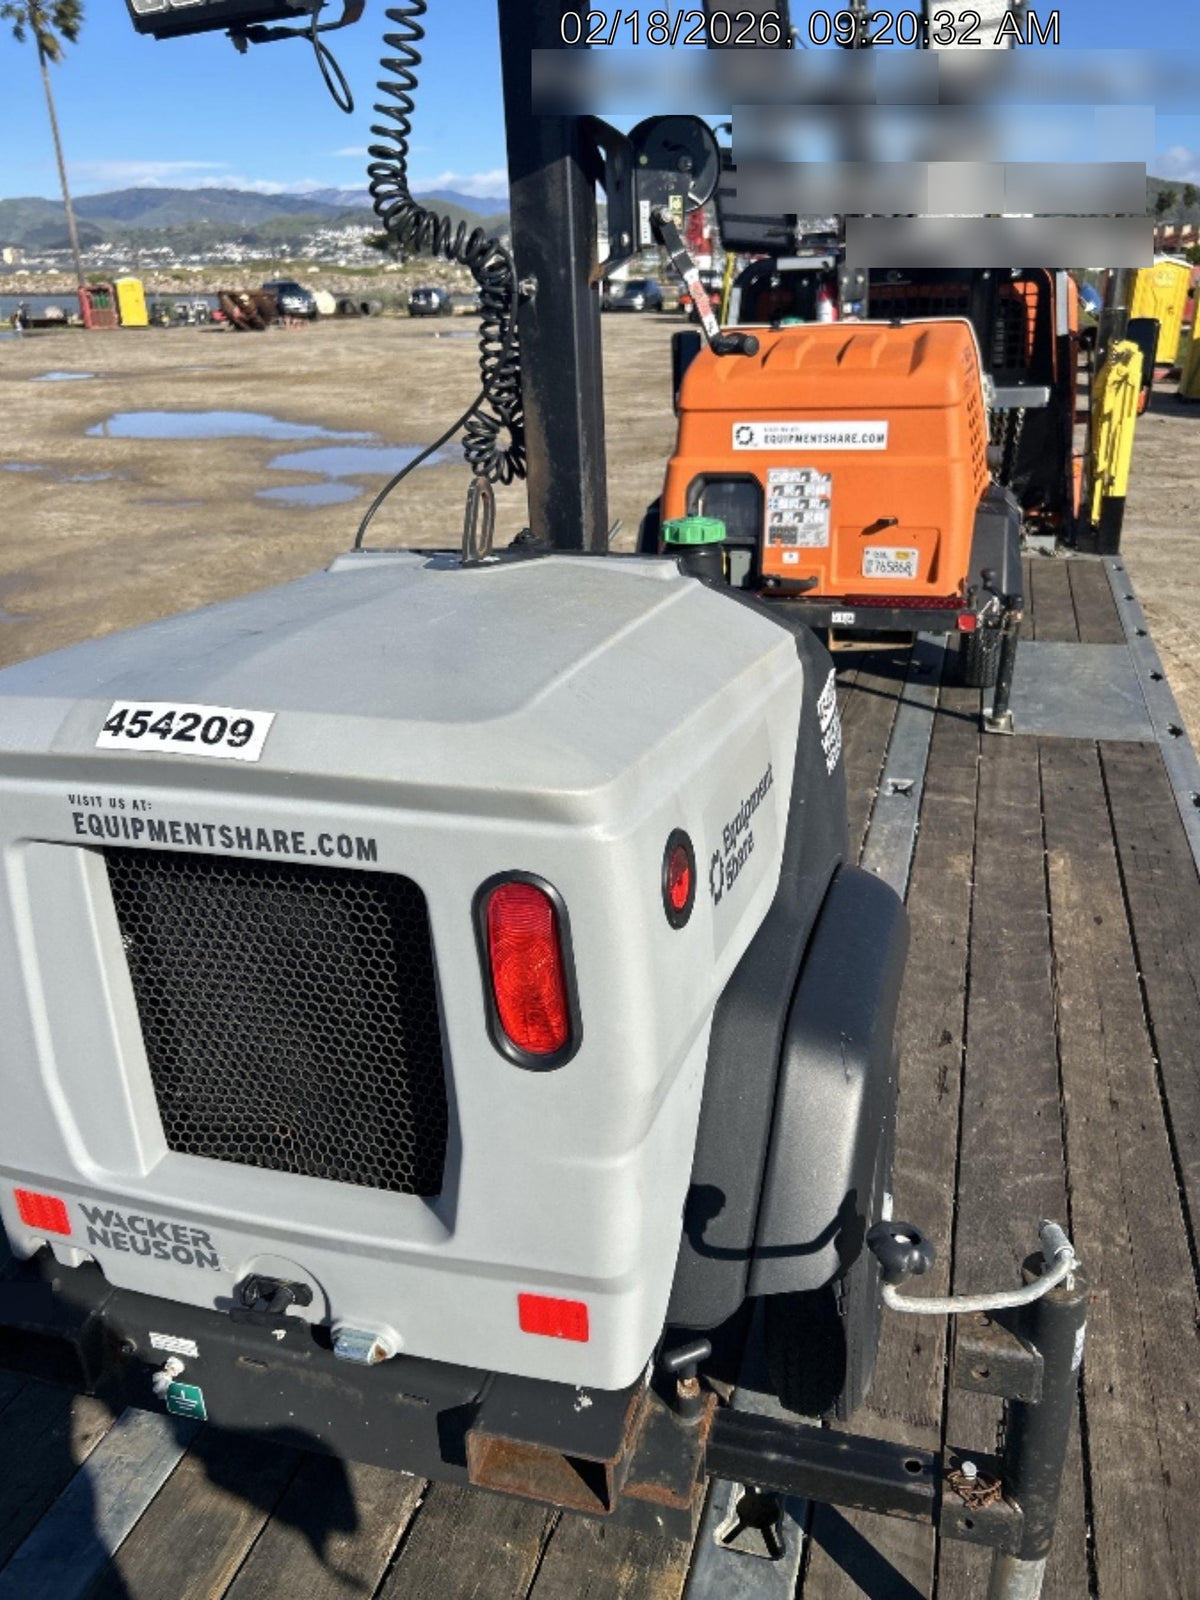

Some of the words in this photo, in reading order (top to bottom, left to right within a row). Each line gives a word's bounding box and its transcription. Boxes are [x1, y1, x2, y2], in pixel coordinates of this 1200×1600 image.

[763, 433, 885, 444] EQUIPMENTSHARE.COM
[102, 708, 255, 748] 454209
[67, 794, 103, 808] VISIT
[109, 797, 126, 810] US
[132, 799, 153, 812] AT:
[723, 762, 774, 858] Equipment
[72, 811, 378, 863] EQUIPMENTSHARE.COM
[725, 830, 755, 892] Share
[78, 1203, 217, 1251] WACKER
[86, 1225, 222, 1273] NEUSON
